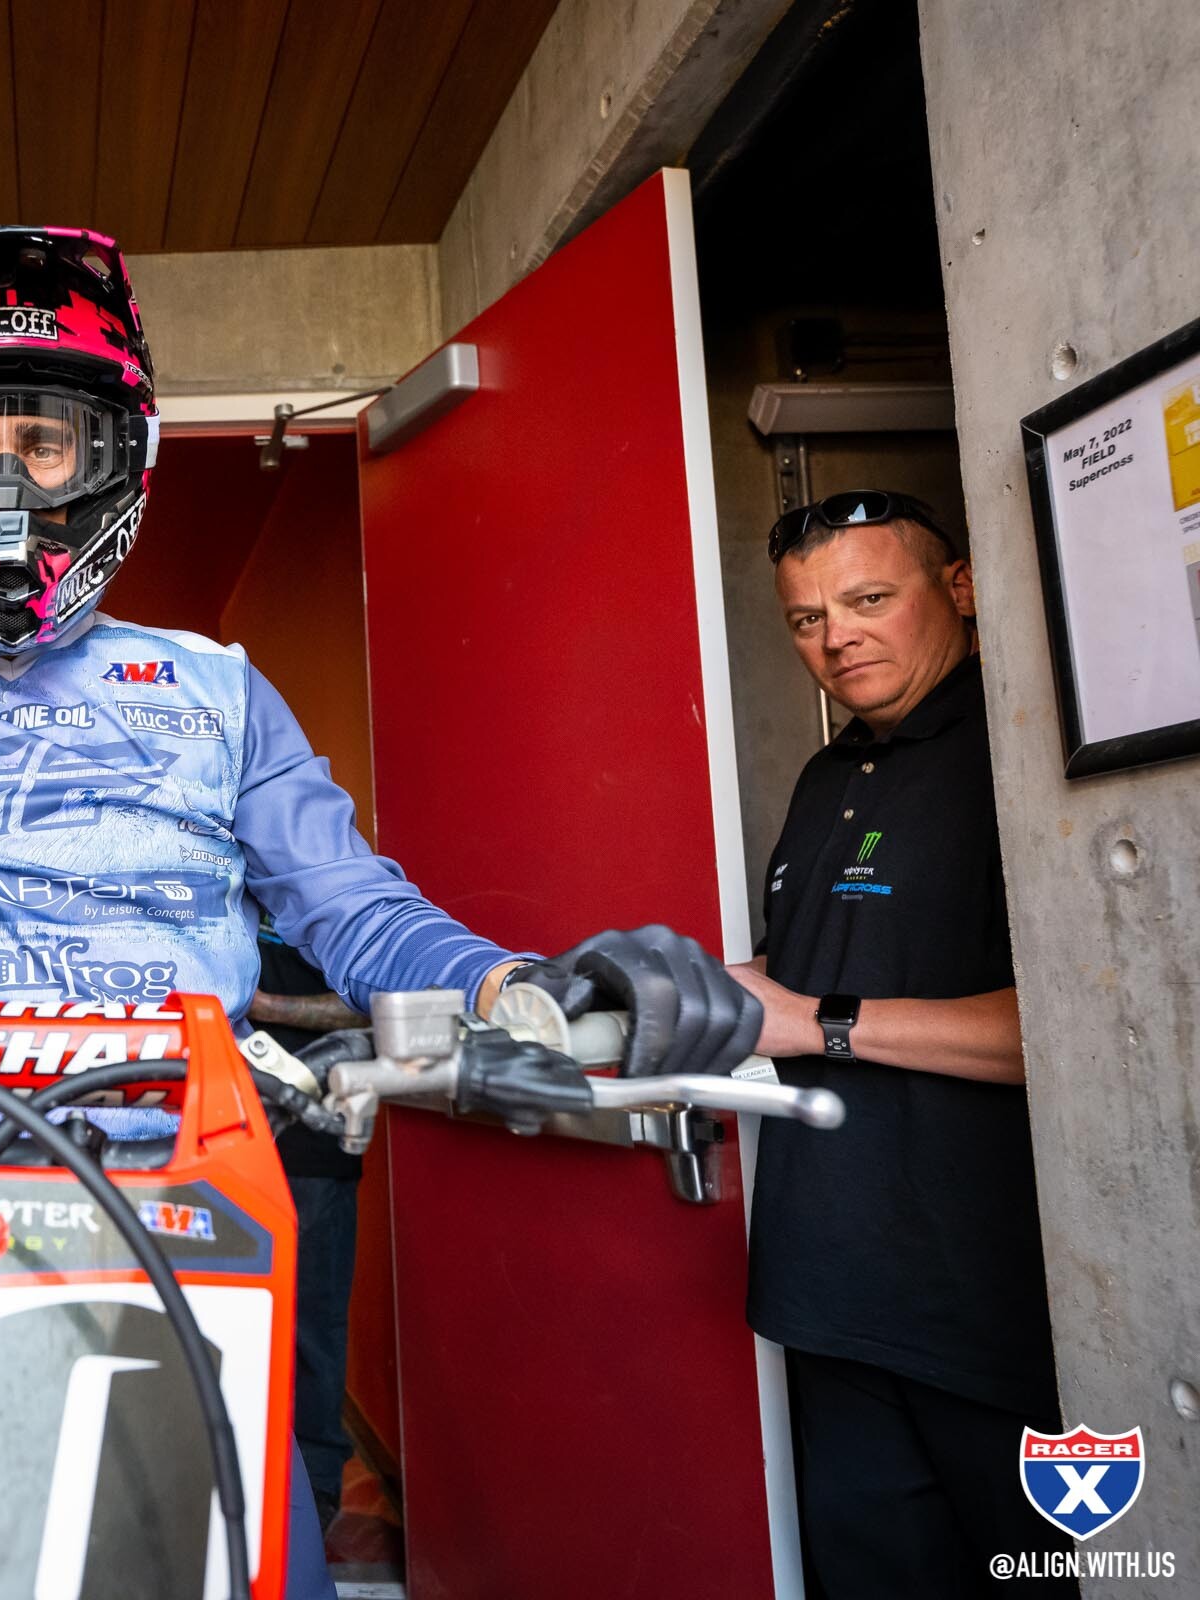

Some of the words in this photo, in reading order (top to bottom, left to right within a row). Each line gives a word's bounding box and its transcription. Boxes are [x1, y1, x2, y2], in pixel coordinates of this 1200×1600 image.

[1063, 445, 1086, 463] May
[1089, 437, 1099, 449] 7,
[1103, 419, 1132, 442] 2022
[1082, 444, 1116, 469] FIELD
[1069, 454, 1134, 491] Supercross
[100, 660, 179, 684] AMA
[55, 705, 93, 727] OIL
[191, 850, 232, 867] DUNLOP
[84, 904, 99, 919] by
[102, 904, 143, 916] Leisure
[147, 905, 195, 919] Concepts
